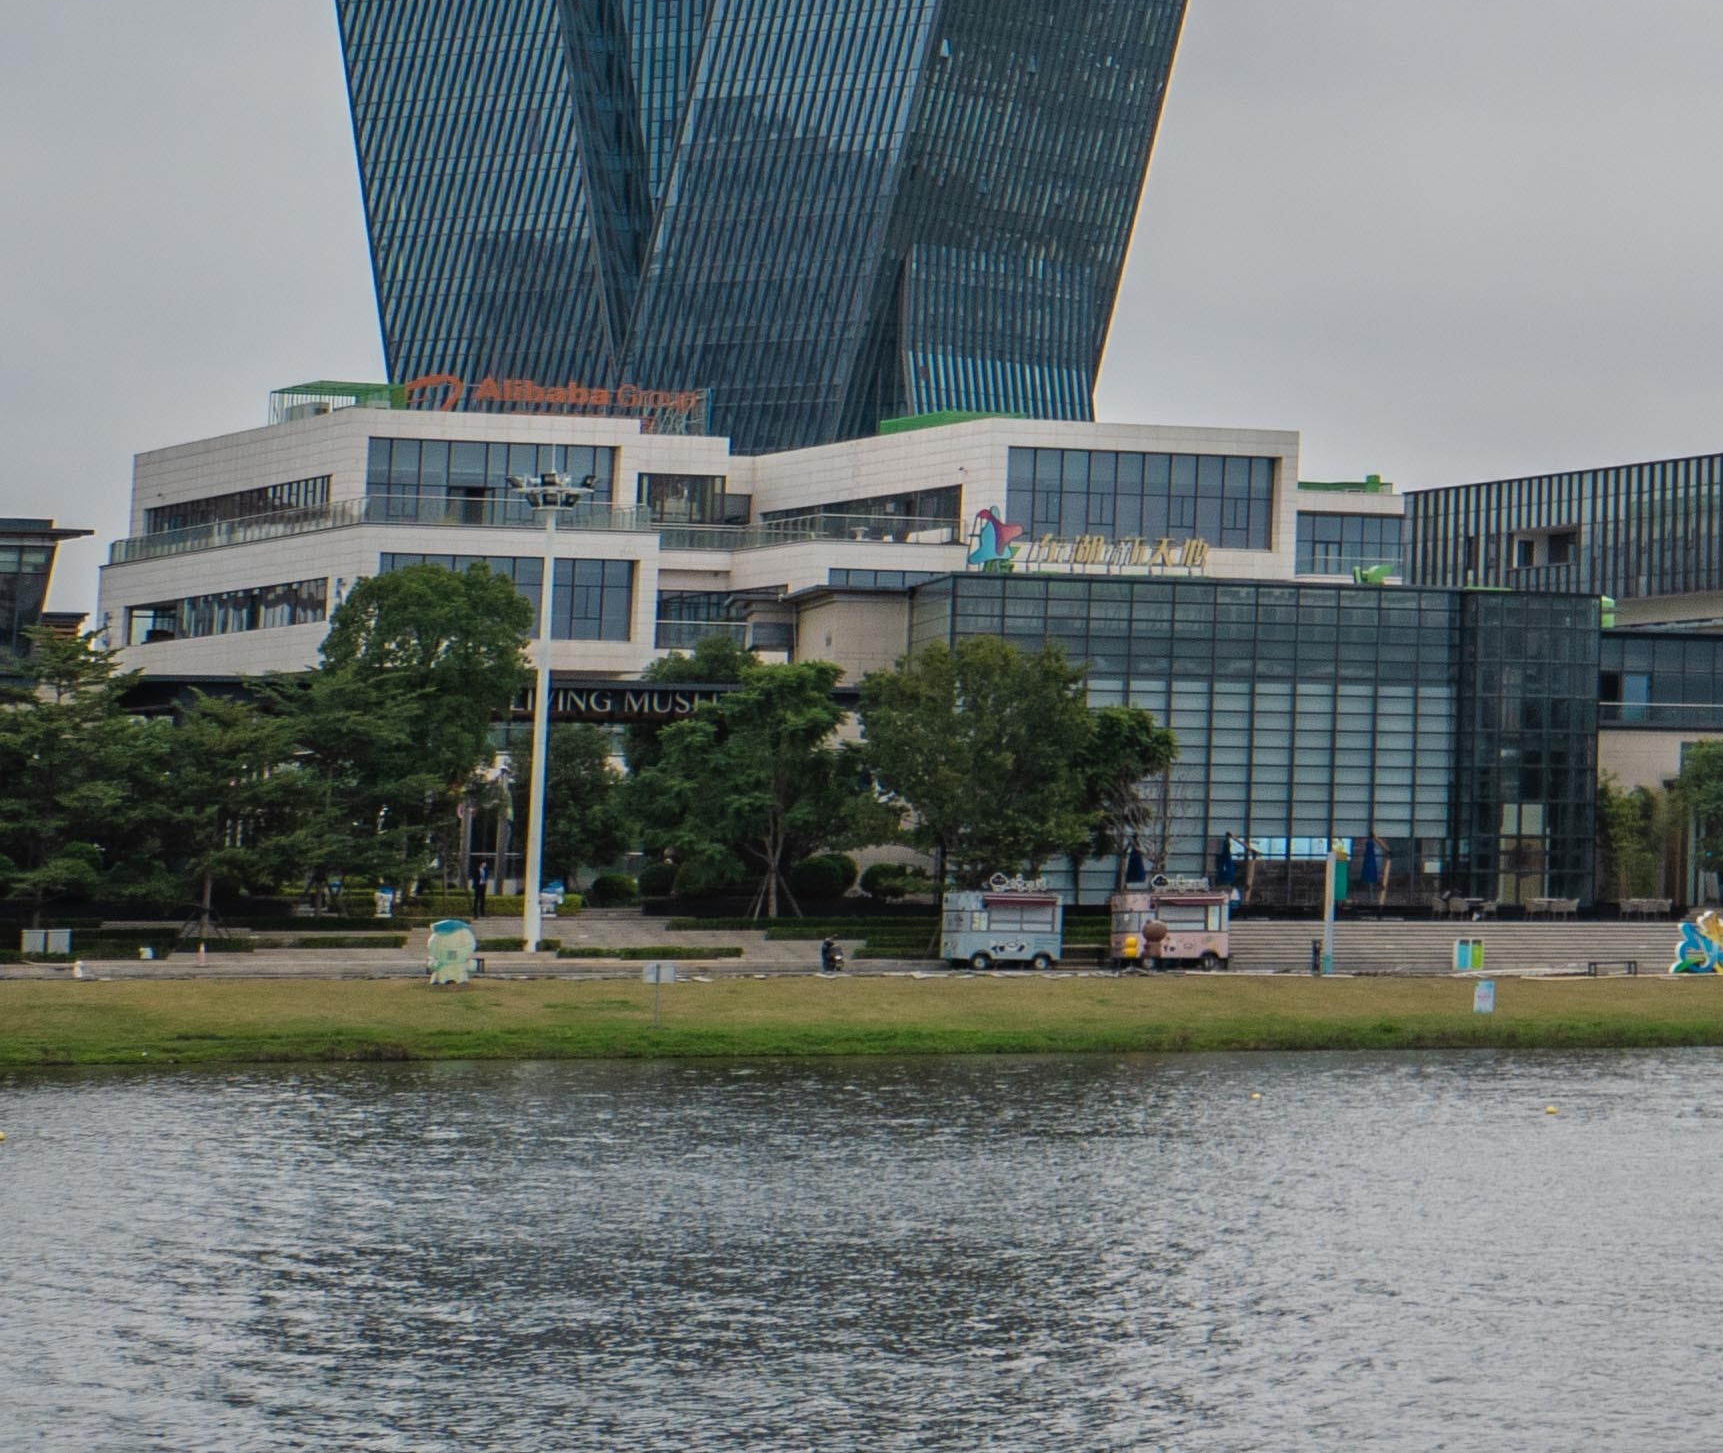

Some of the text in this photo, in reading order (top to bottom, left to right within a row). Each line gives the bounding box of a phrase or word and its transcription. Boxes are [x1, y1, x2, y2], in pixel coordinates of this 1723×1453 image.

[475, 376, 704, 414] Alibaba Group
[510, 690, 612, 714] LIING
